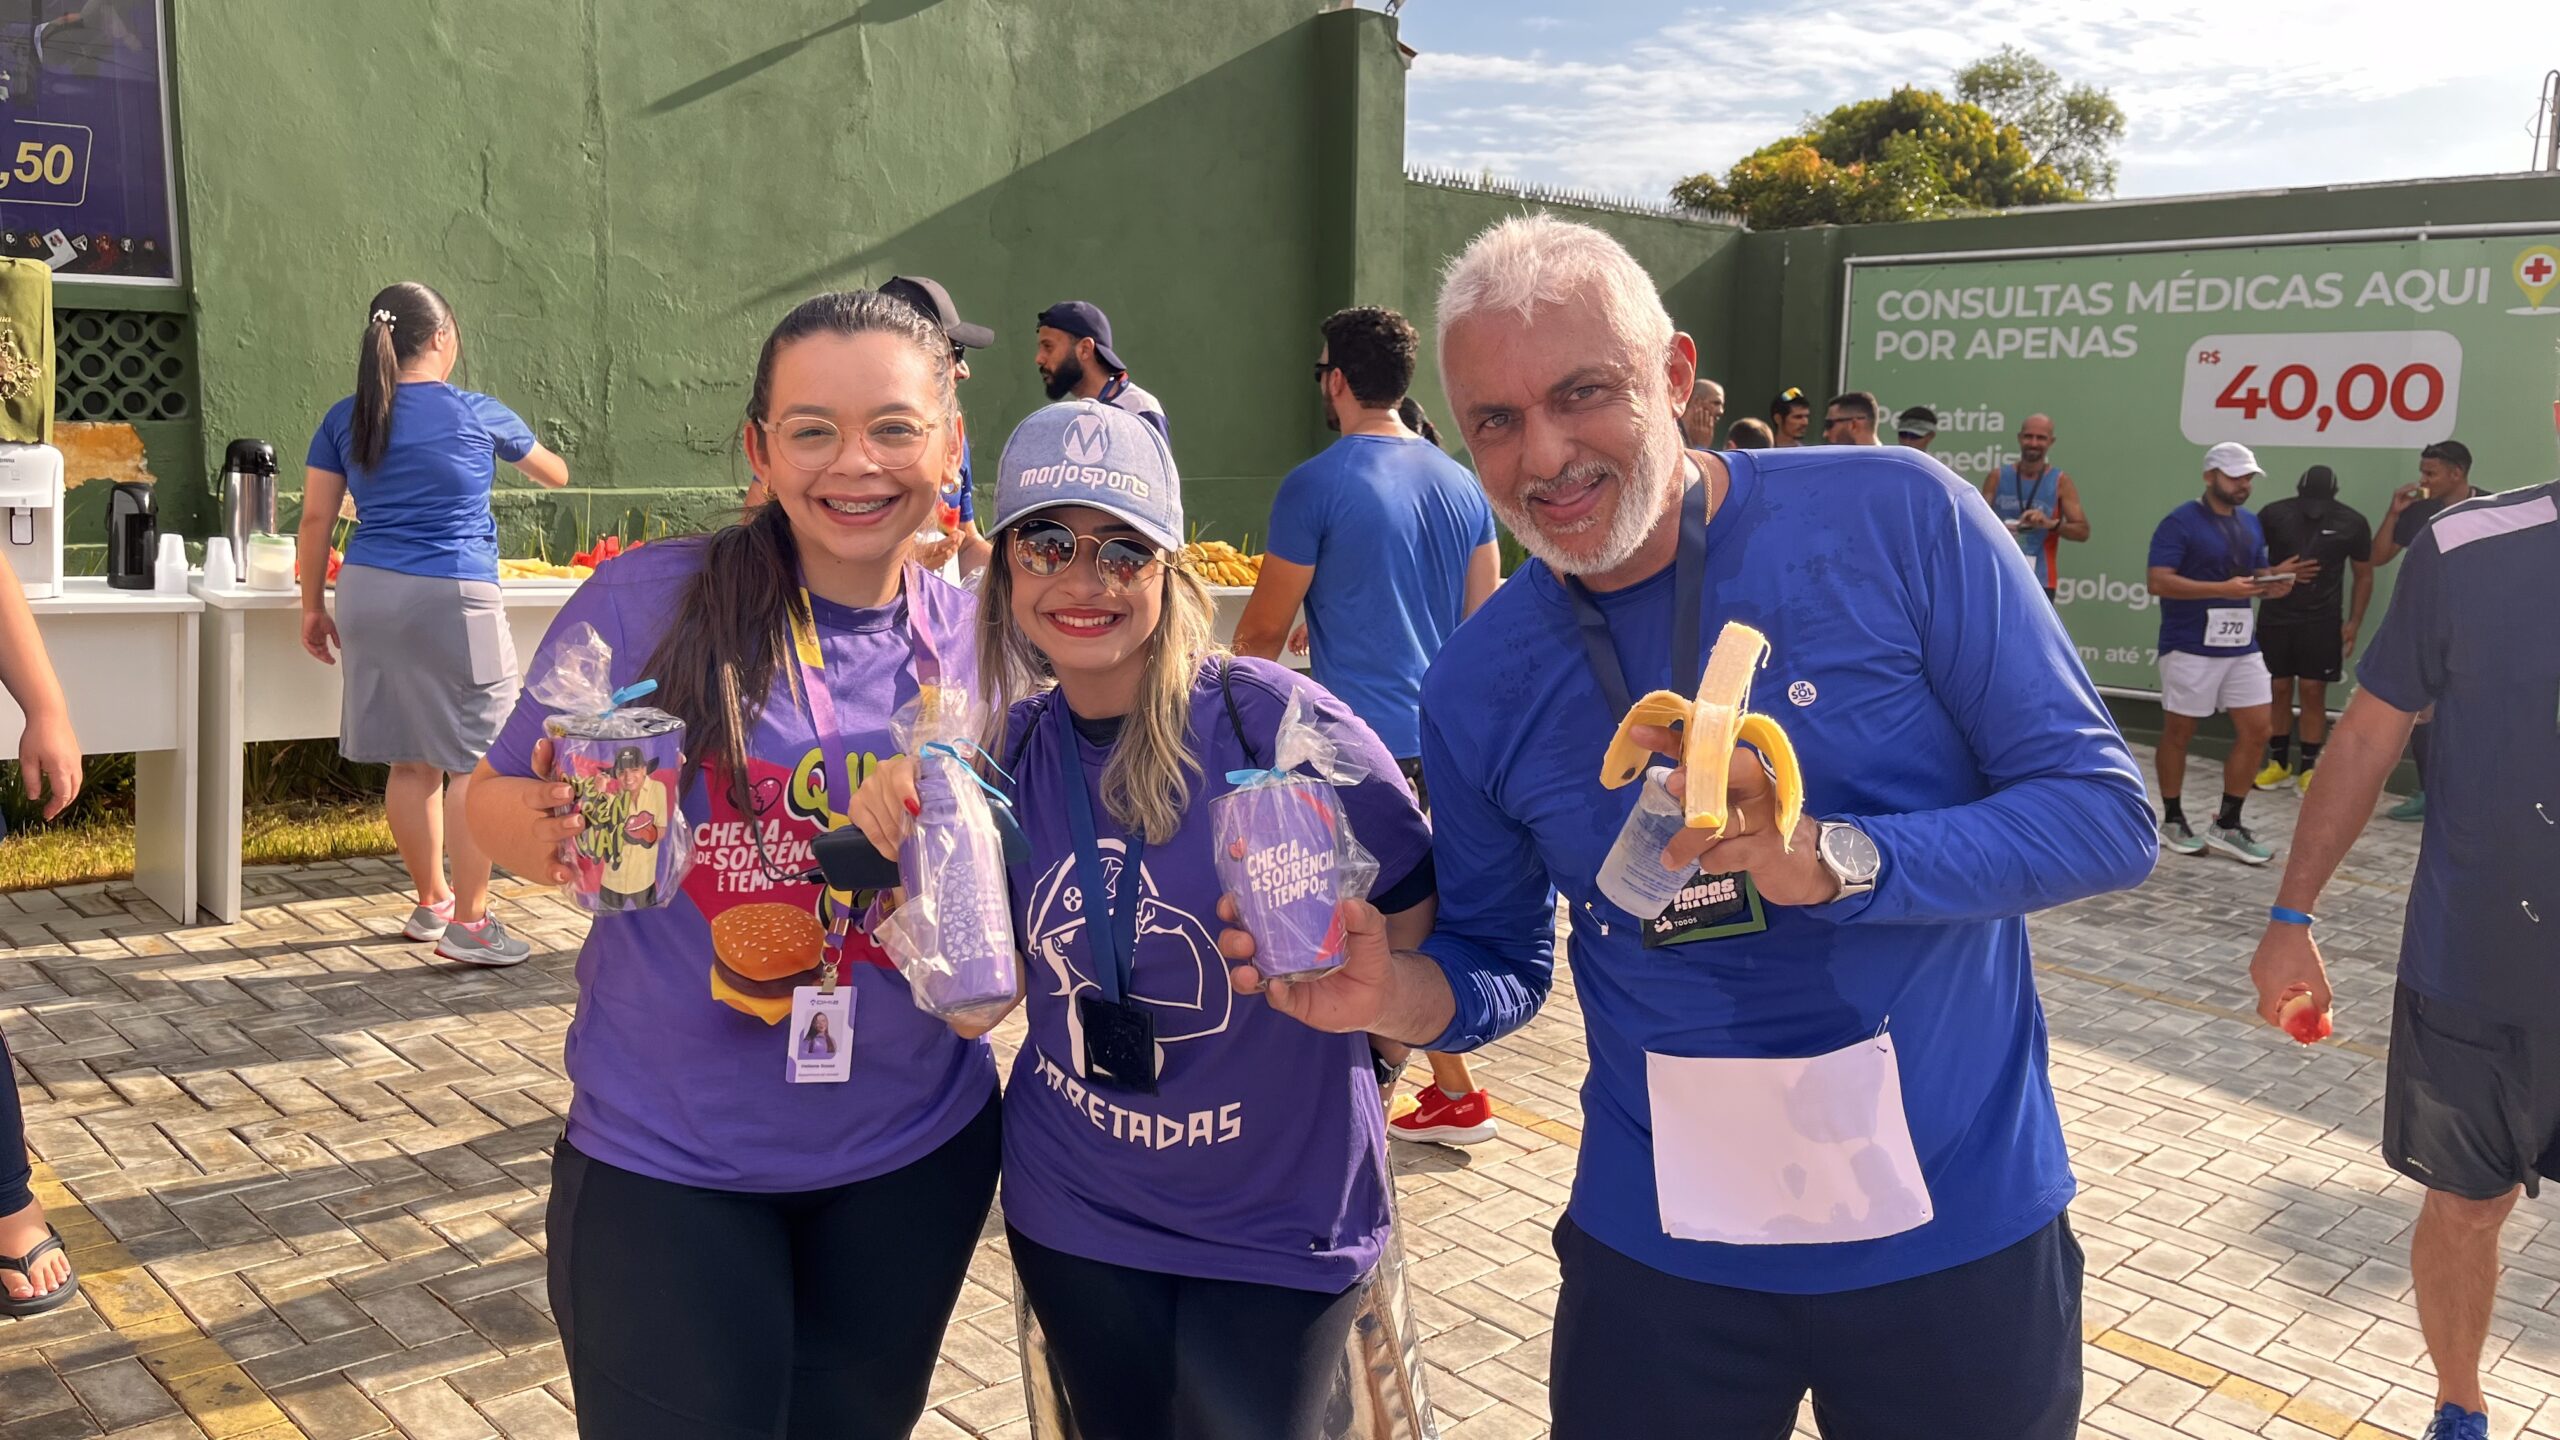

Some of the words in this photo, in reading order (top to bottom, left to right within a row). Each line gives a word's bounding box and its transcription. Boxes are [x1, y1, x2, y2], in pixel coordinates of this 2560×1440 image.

[1876, 282, 2114, 322] CONSULTAS
[2126, 269, 2344, 315] MÉDICAS
[2355, 267, 2491, 313] AQUI
[1875, 329, 1956, 361] POR
[1964, 324, 2139, 360] APENAS
[2198, 350, 2221, 365] R$
[2215, 363, 2444, 432] 40,00
[1877, 404, 2004, 432] Peatria
[2218, 622, 2244, 635] 370
[2105, 646, 2140, 665] até
[1791, 687, 1815, 700] SOL
[696, 851, 712, 865] DE
[1247, 839, 1300, 877] CHEGA
[1251, 878, 1261, 892] DE
[1262, 848, 1335, 892] SOFRÊNCIA
[717, 871, 725, 892] É
[1273, 875, 1319, 908] TEMPO
[1673, 916, 1698, 928] TODOS
